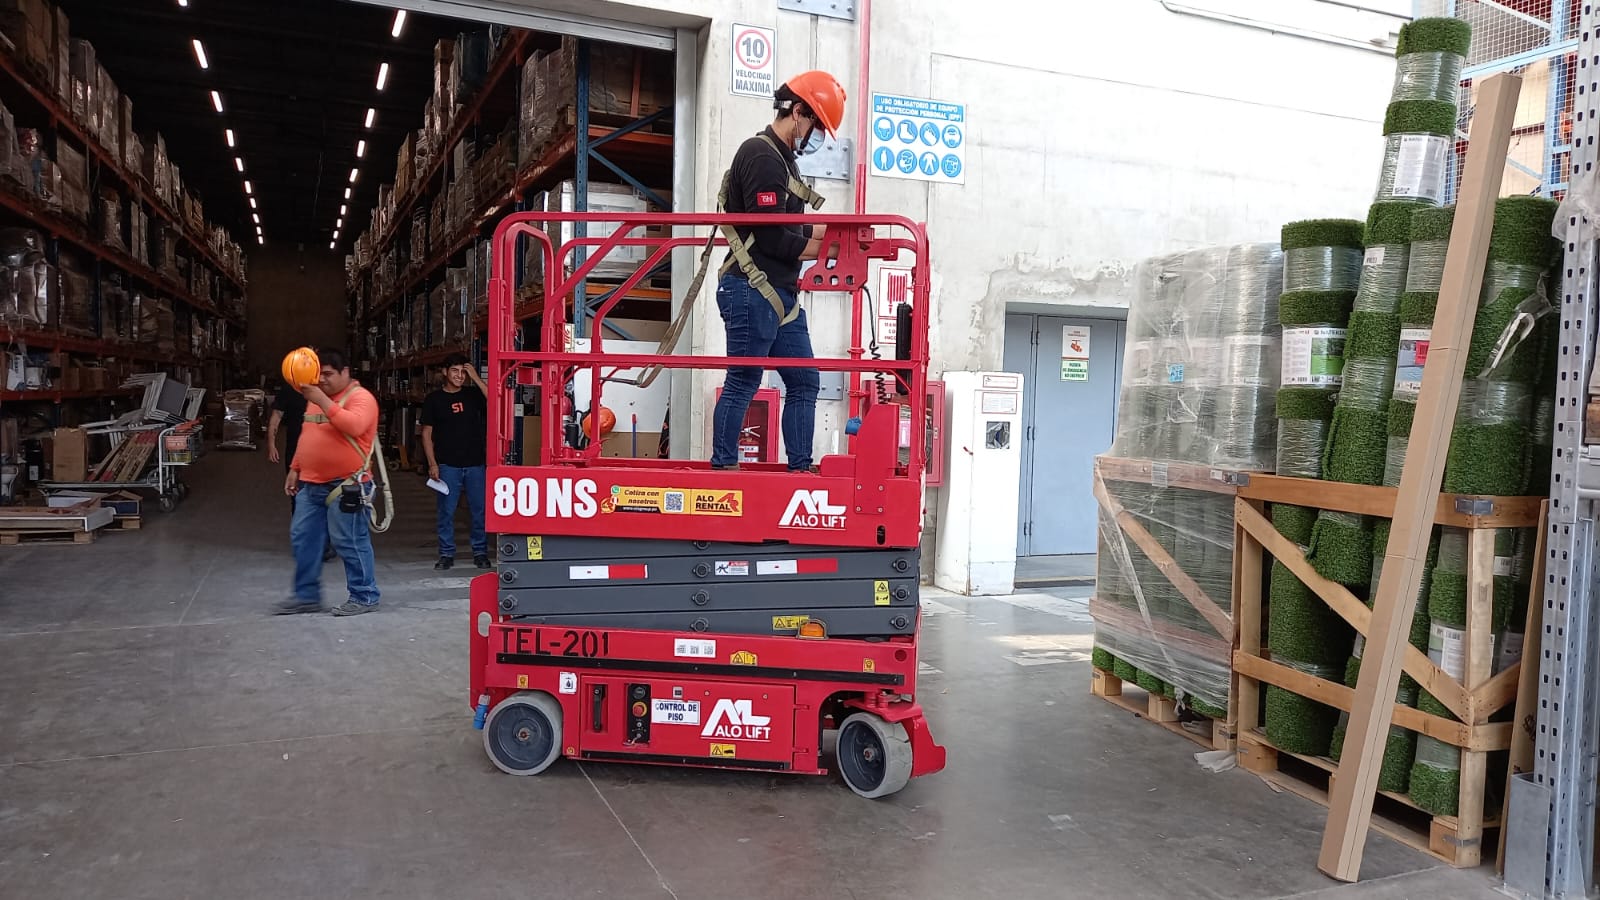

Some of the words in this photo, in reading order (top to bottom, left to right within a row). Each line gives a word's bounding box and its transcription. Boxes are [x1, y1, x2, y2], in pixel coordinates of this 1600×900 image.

[742, 37, 765, 58] 10
[735, 69, 772, 81] VELOCIDAD
[735, 79, 772, 94] MAXIMA
[880, 97, 892, 105] USO
[893, 99, 929, 110] OBLIGATORIO
[929, 103, 938, 111] DE
[938, 104, 958, 113] EQUIPO
[919, 110, 948, 120] PERSONAL
[494, 477, 539, 517] 80
[546, 478, 598, 518] NS
[624, 489, 646, 497] Cotiza
[695, 502, 731, 510] RENTAL
[791, 514, 819, 527] ALO
[821, 515, 847, 528] LIFT
[501, 627, 609, 657] TEL-201
[655, 702, 687, 712] CONTROL
[688, 704, 697, 712] DE
[667, 713, 684, 721] PISO
[714, 724, 743, 737] ALO
[745, 726, 771, 739] LIFT
